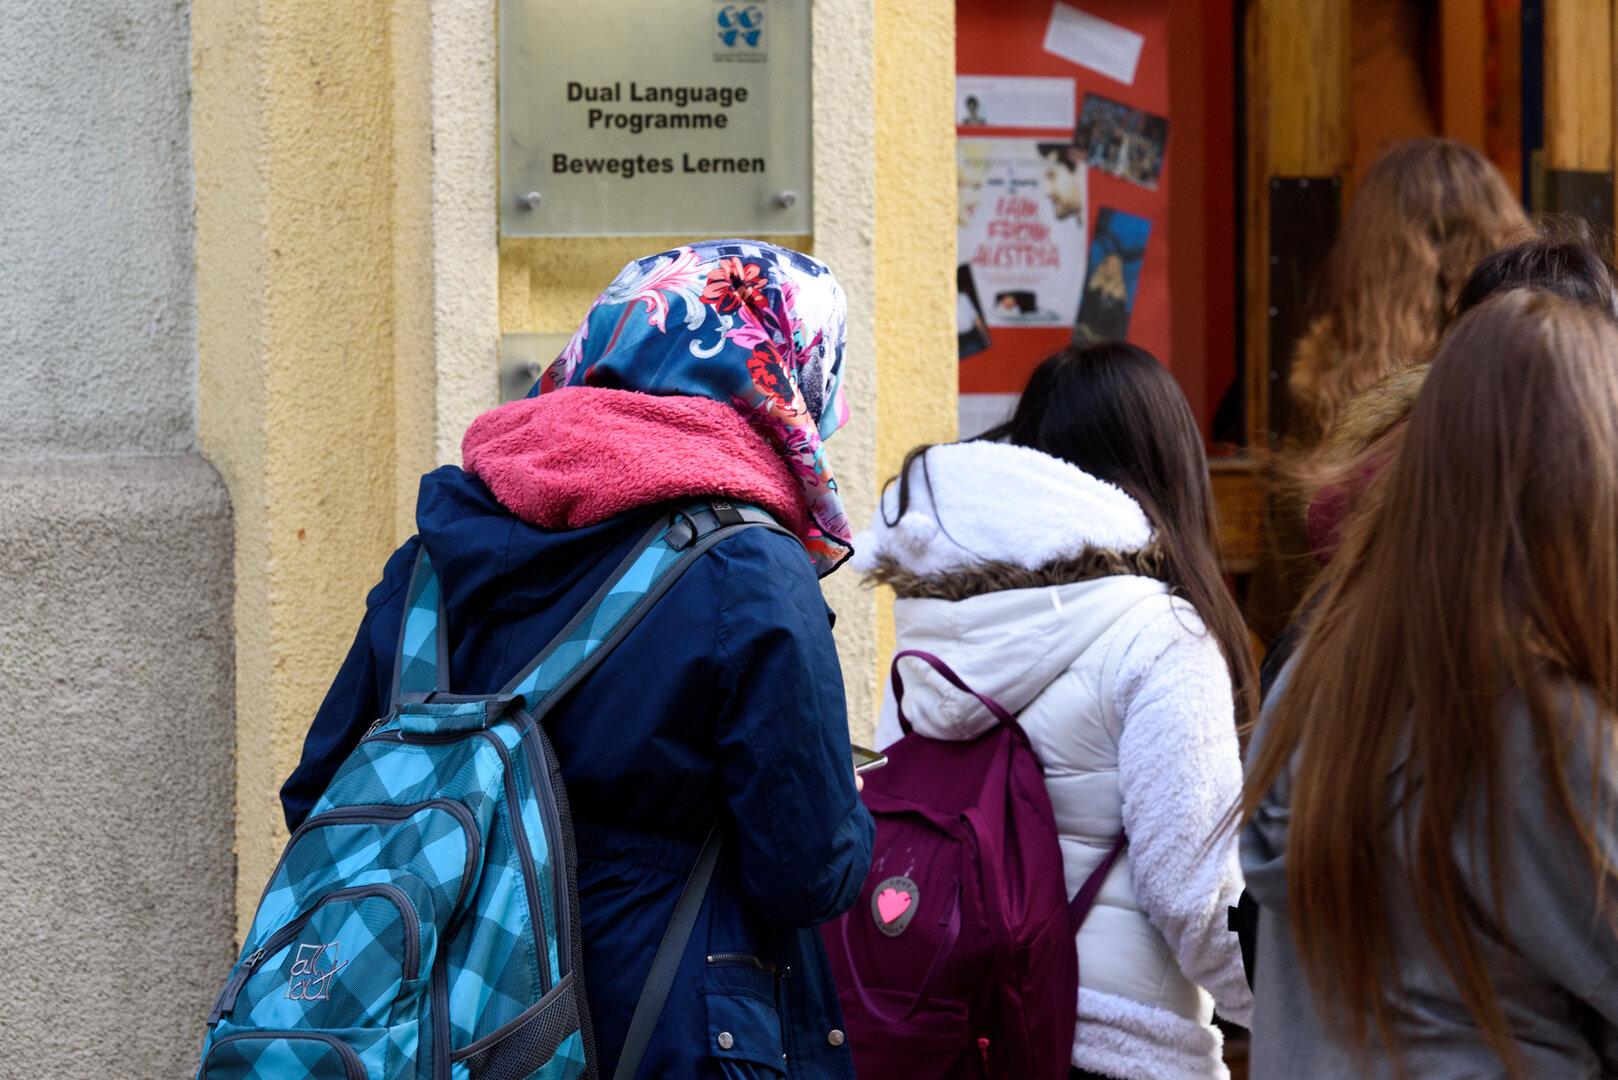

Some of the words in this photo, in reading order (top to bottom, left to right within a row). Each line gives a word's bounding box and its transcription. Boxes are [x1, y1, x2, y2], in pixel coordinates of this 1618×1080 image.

[566, 81, 622, 103] Dual
[629, 81, 749, 108] Language
[587, 108, 729, 134] Programme
[551, 152, 675, 179] Bewegtes
[682, 152, 767, 174] Lernen
